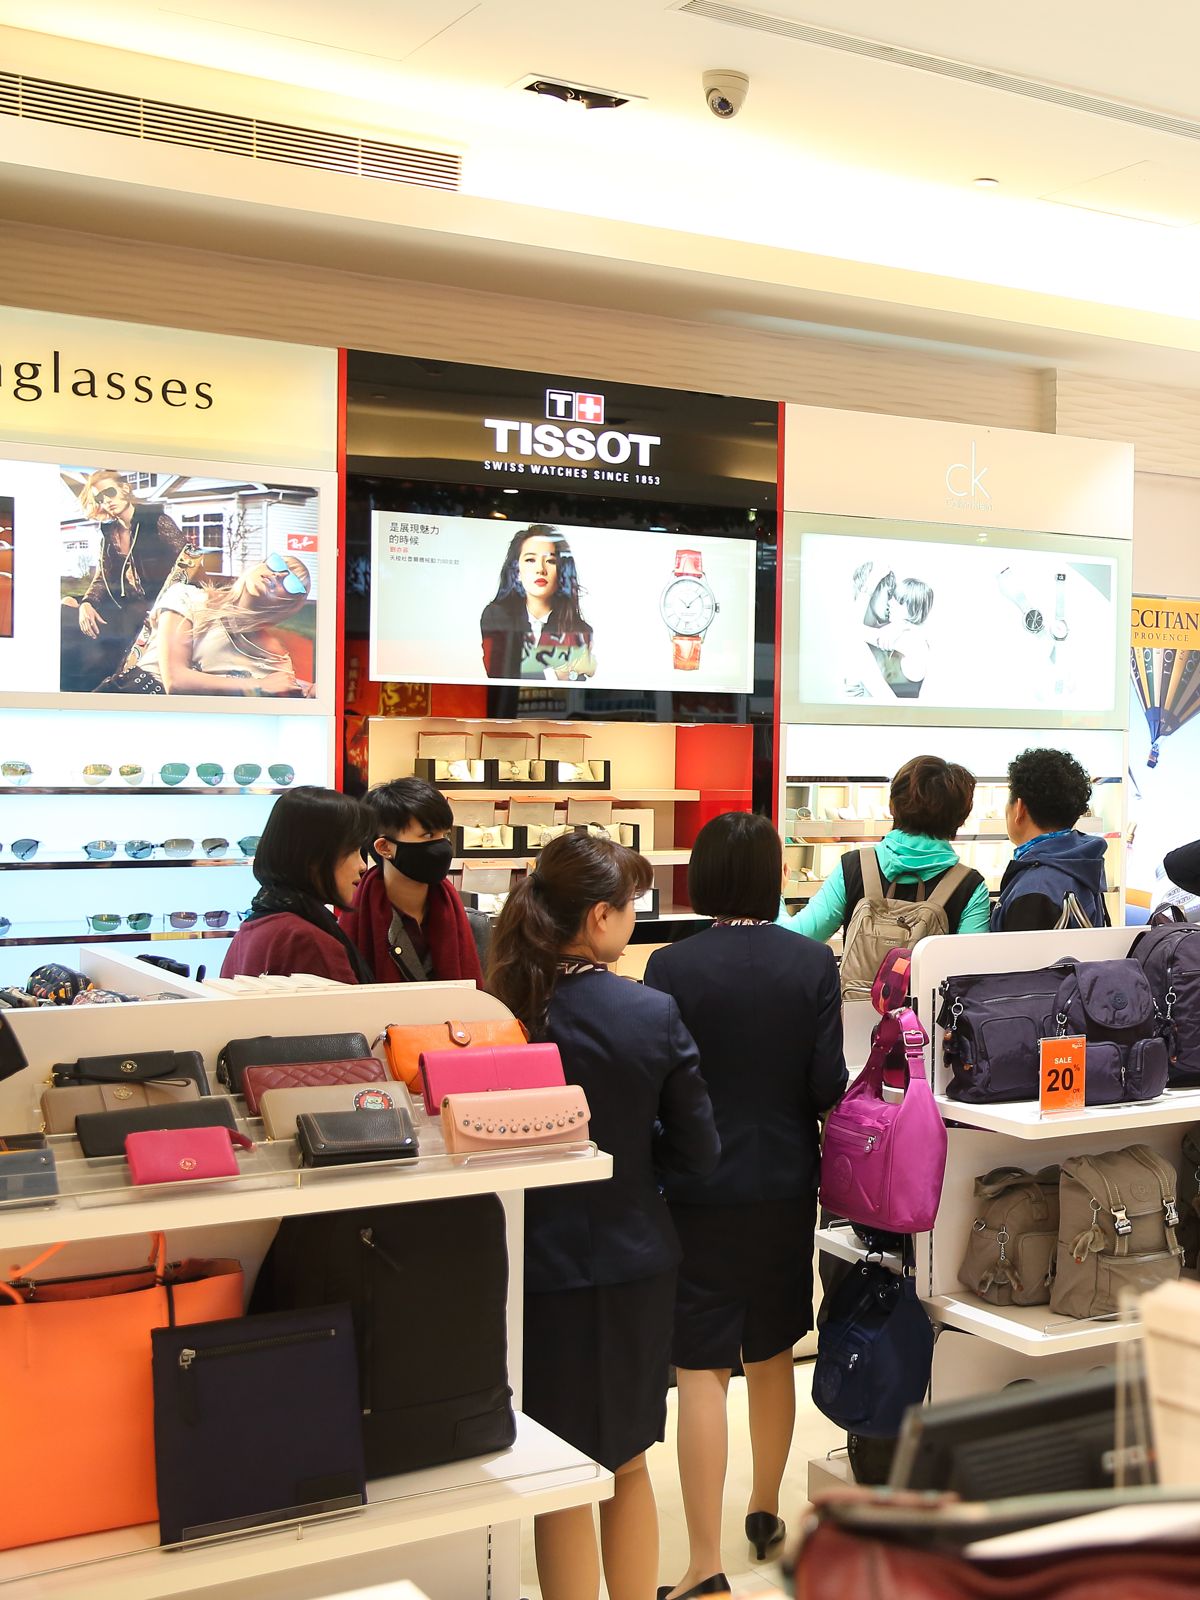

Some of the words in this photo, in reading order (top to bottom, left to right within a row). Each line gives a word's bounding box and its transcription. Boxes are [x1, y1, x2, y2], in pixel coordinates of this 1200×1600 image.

[0, 351, 214, 410] glasses
[484, 418, 661, 467] TISSOT
[484, 460, 525, 474] SWISS
[530, 464, 588, 479] WATCHES
[593, 470, 630, 483] SINCE
[634, 474, 661, 486] 1853
[946, 440, 992, 500] ck
[389, 522, 440, 535] 是展現魅力
[389, 534, 420, 546] 的時候
[1134, 631, 1190, 642] PROVENCE
[1054, 1056, 1073, 1065] SALE
